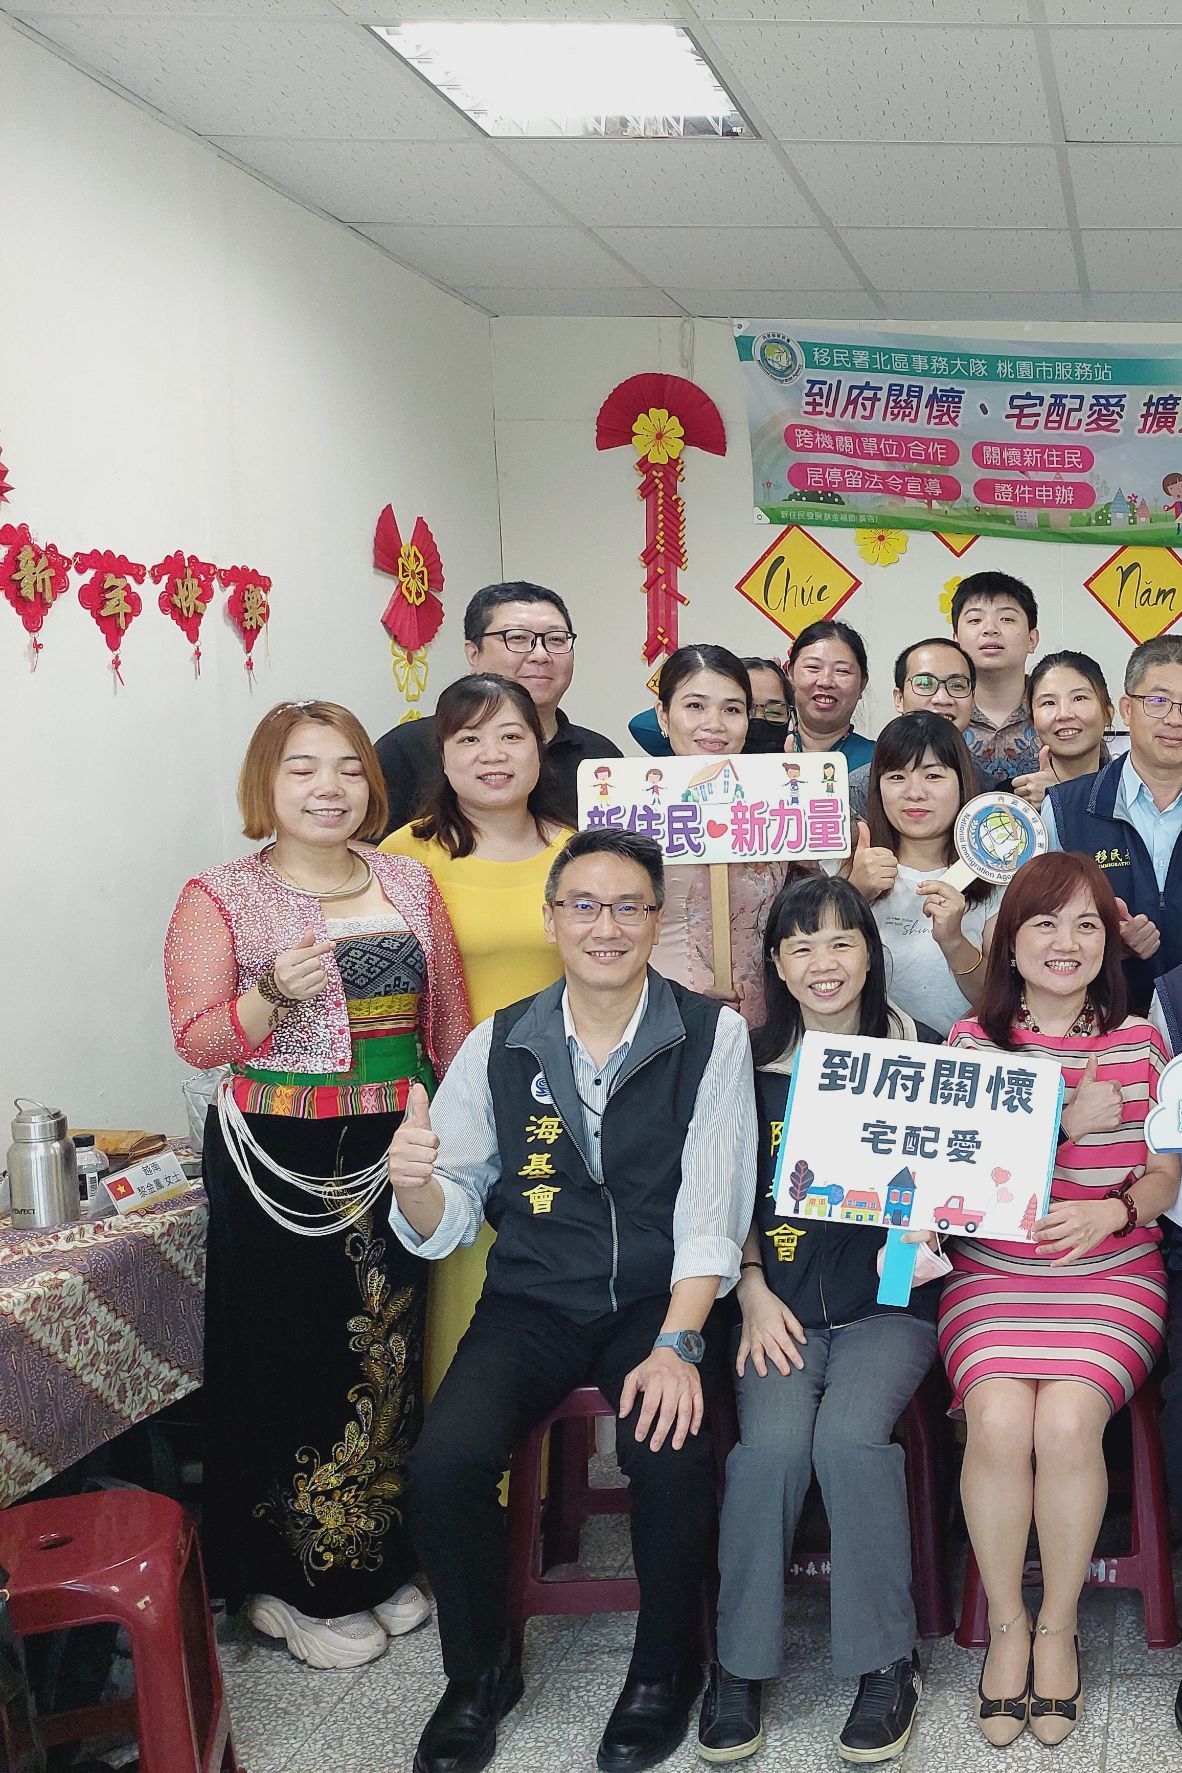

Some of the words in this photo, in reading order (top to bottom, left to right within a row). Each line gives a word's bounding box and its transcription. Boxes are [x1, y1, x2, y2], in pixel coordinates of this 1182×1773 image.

[812, 347, 988, 377] 移民署北區事務大隊
[996, 359, 1112, 382] 桃園市服務站
[795, 428, 948, 461] 跨機關(單位)合作
[982, 446, 1083, 469] 關懷新住民
[806, 467, 943, 498] 居停留法令宣導
[994, 483, 1075, 505] 證件申辦
[763, 555, 830, 612] Chúc
[1115, 561, 1177, 612] Năm
[730, 798, 846, 854] 新力量
[958, 812, 972, 843] National
[960, 844, 996, 879] Immigration
[996, 872, 1016, 882] Age
[1098, 860, 1130, 869] IMMIGRATIO
[818, 1048, 1038, 1114] 到府關懷
[861, 1119, 982, 1165] 宅配愛
[164, 1170, 182, 1187] 女士
[517, 1115, 564, 1215] 海基會
